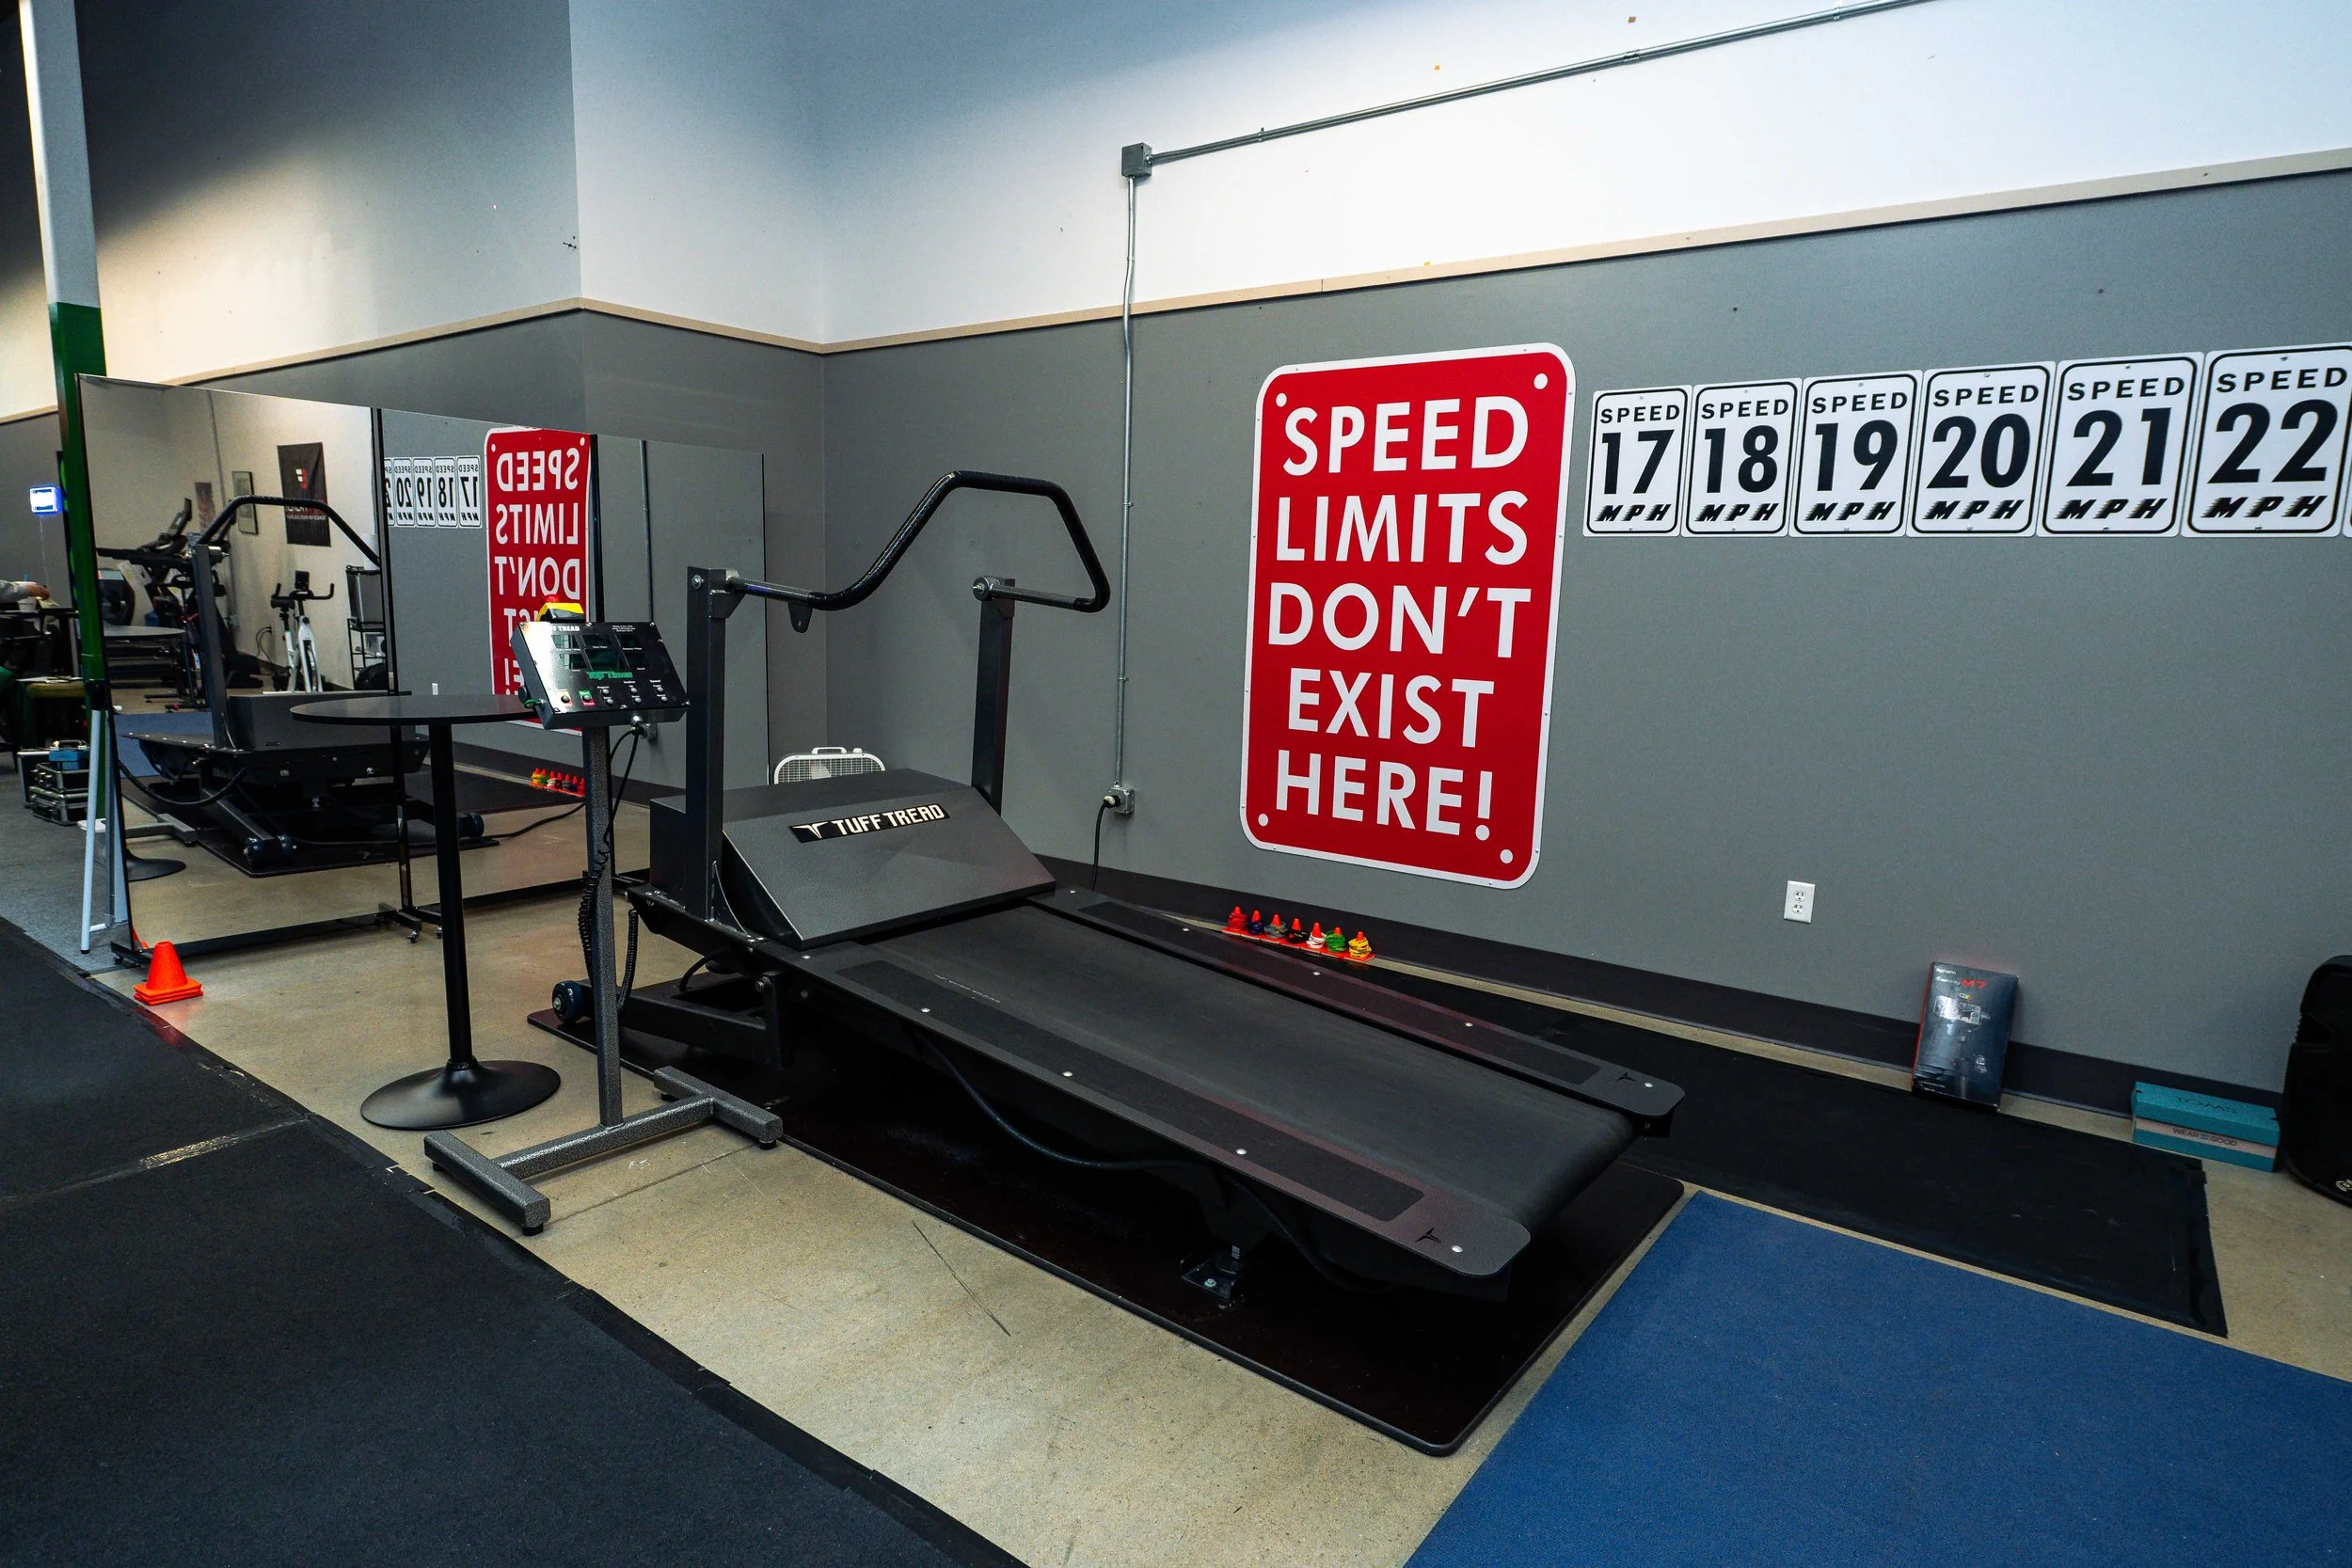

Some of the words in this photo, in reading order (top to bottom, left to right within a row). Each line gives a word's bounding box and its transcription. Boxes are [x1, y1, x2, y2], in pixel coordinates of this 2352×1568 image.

[2067, 376, 2185, 402] SPEED
[2216, 367, 2348, 393] SPEED
[1811, 391, 1908, 414] SPEED
[1932, 384, 2040, 407] SPEED
[1599, 404, 1680, 424] SPEED
[1701, 398, 1789, 420] SPEED
[1283, 394, 1529, 477] SPEED
[2065, 406, 2172, 488] 21
[2206, 398, 2339, 484] 22
[1601, 429, 1675, 496] 17
[1704, 423, 1779, 494] 18
[1815, 419, 1899, 492] 19
[1926, 412, 2031, 489] 20
[1594, 503, 1672, 522] MPH
[1694, 502, 1779, 522] MPH
[1804, 500, 1897, 522] MPH
[1921, 499, 2026, 520] MPH
[2055, 498, 2169, 520] MPH
[2201, 495, 2328, 518] MPH
[1276, 490, 1529, 565] LIMITS
[1268, 582, 1532, 658] DON'T
[1288, 668, 1495, 748] EXIST
[1276, 750, 1493, 842] HERE!
[831, 814, 882, 836] TUFF
[881, 804, 946, 828] TREAD
[2173, 1128, 2200, 1139] WEAR
[2211, 1135, 2238, 1147] GOOD
